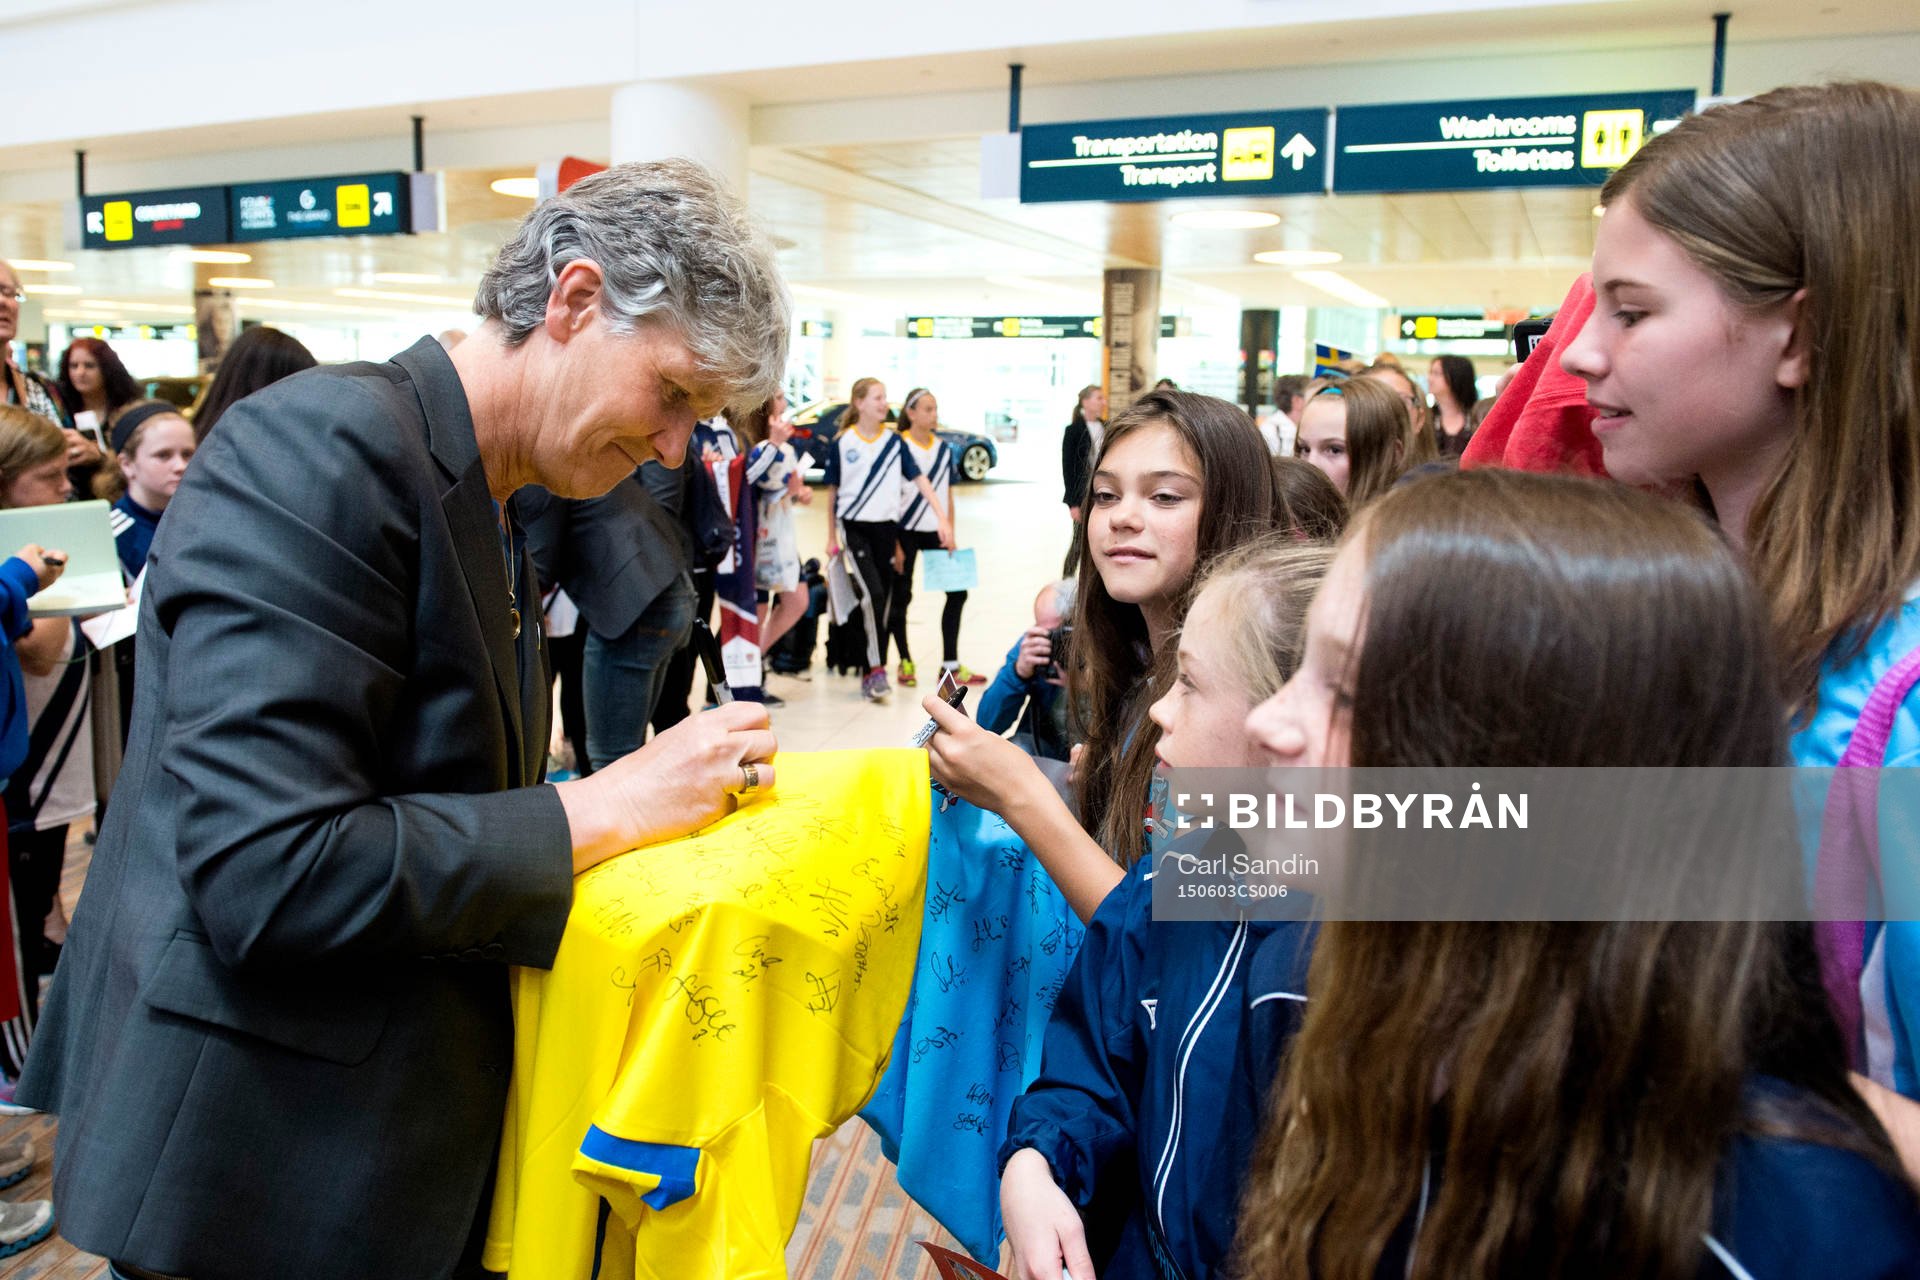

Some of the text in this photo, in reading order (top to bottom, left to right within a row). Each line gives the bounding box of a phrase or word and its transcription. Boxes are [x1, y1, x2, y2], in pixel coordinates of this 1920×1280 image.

[1440, 114, 1576, 139] Washrooms
[1072, 129, 1218, 157] Transportation
[1473, 147, 1574, 172] Toilettes
[1120, 162, 1217, 188] Transport
